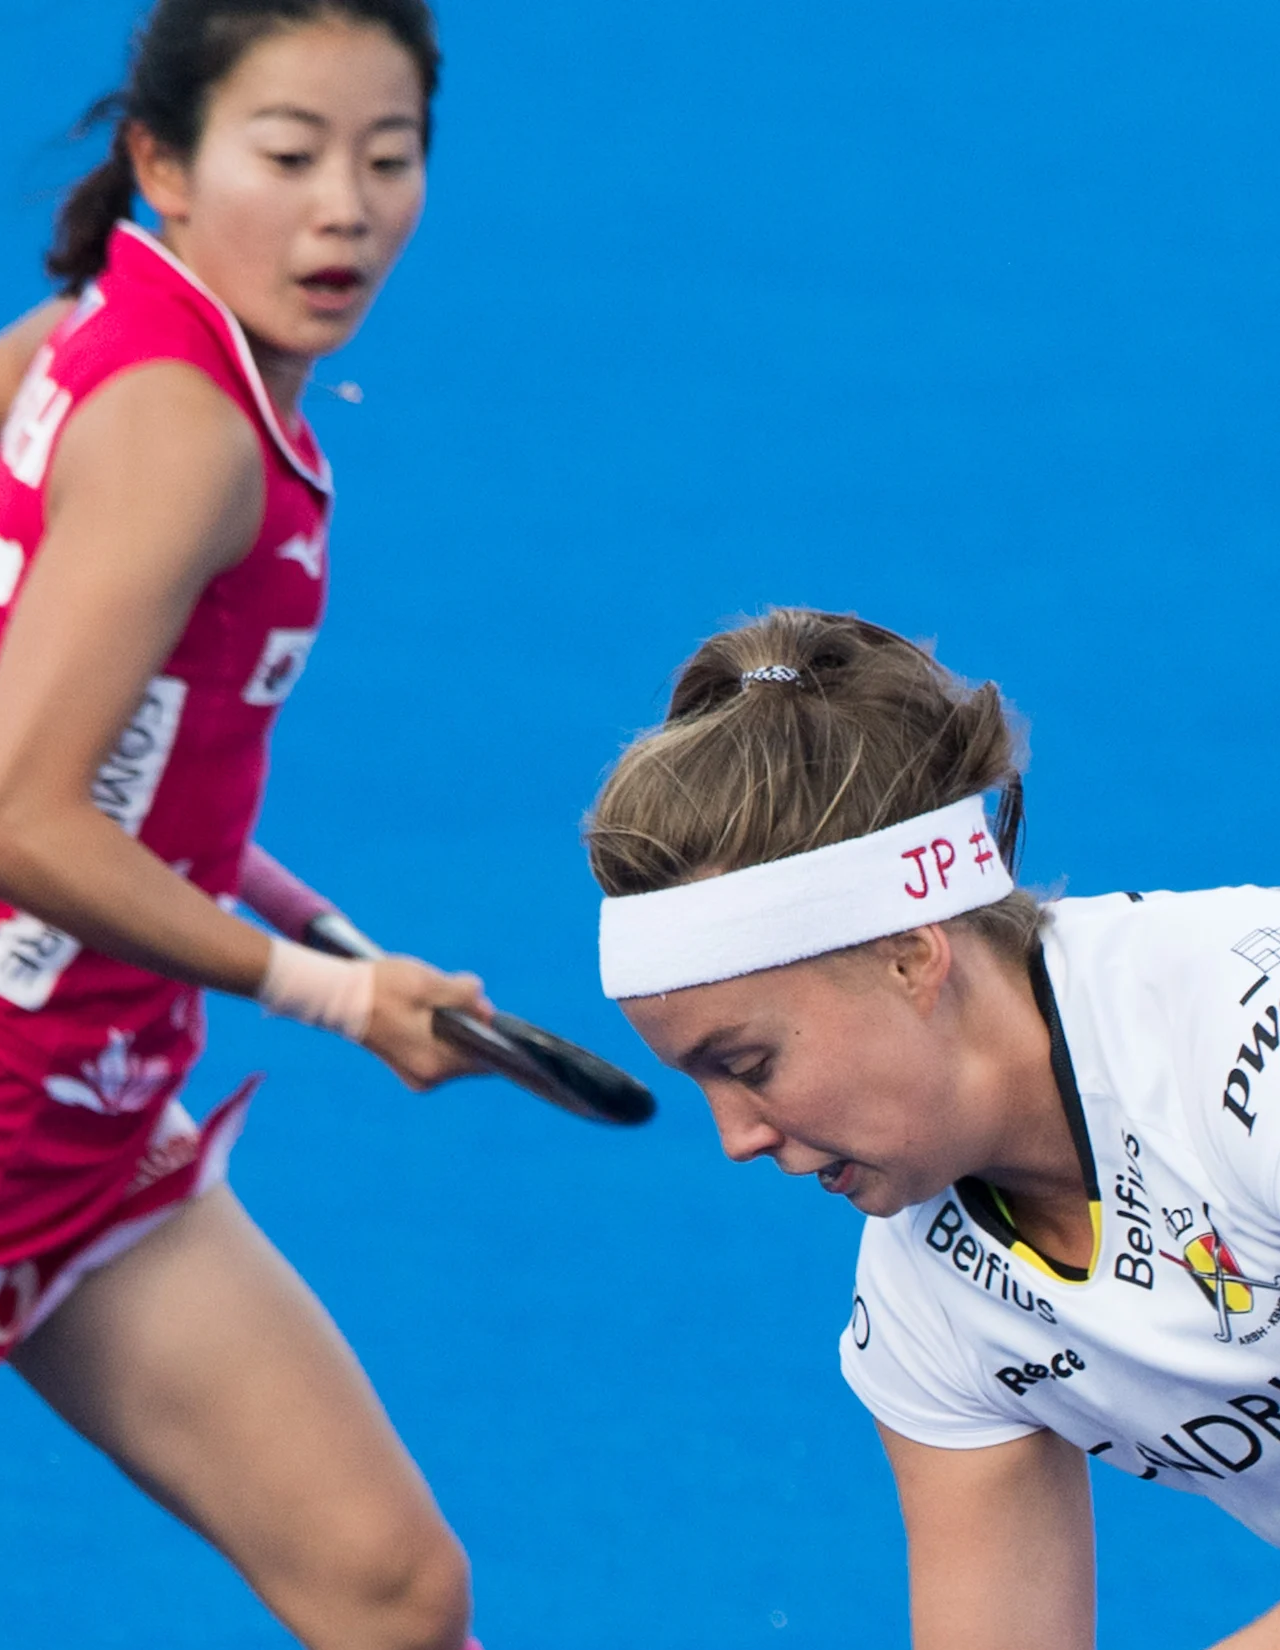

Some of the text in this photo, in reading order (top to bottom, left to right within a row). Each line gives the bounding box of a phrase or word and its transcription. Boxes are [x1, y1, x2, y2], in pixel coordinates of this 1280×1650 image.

[900, 838, 957, 900] JP
[924, 1199, 1059, 1325] Belfius
[1114, 1127, 1154, 1290] Belfius
